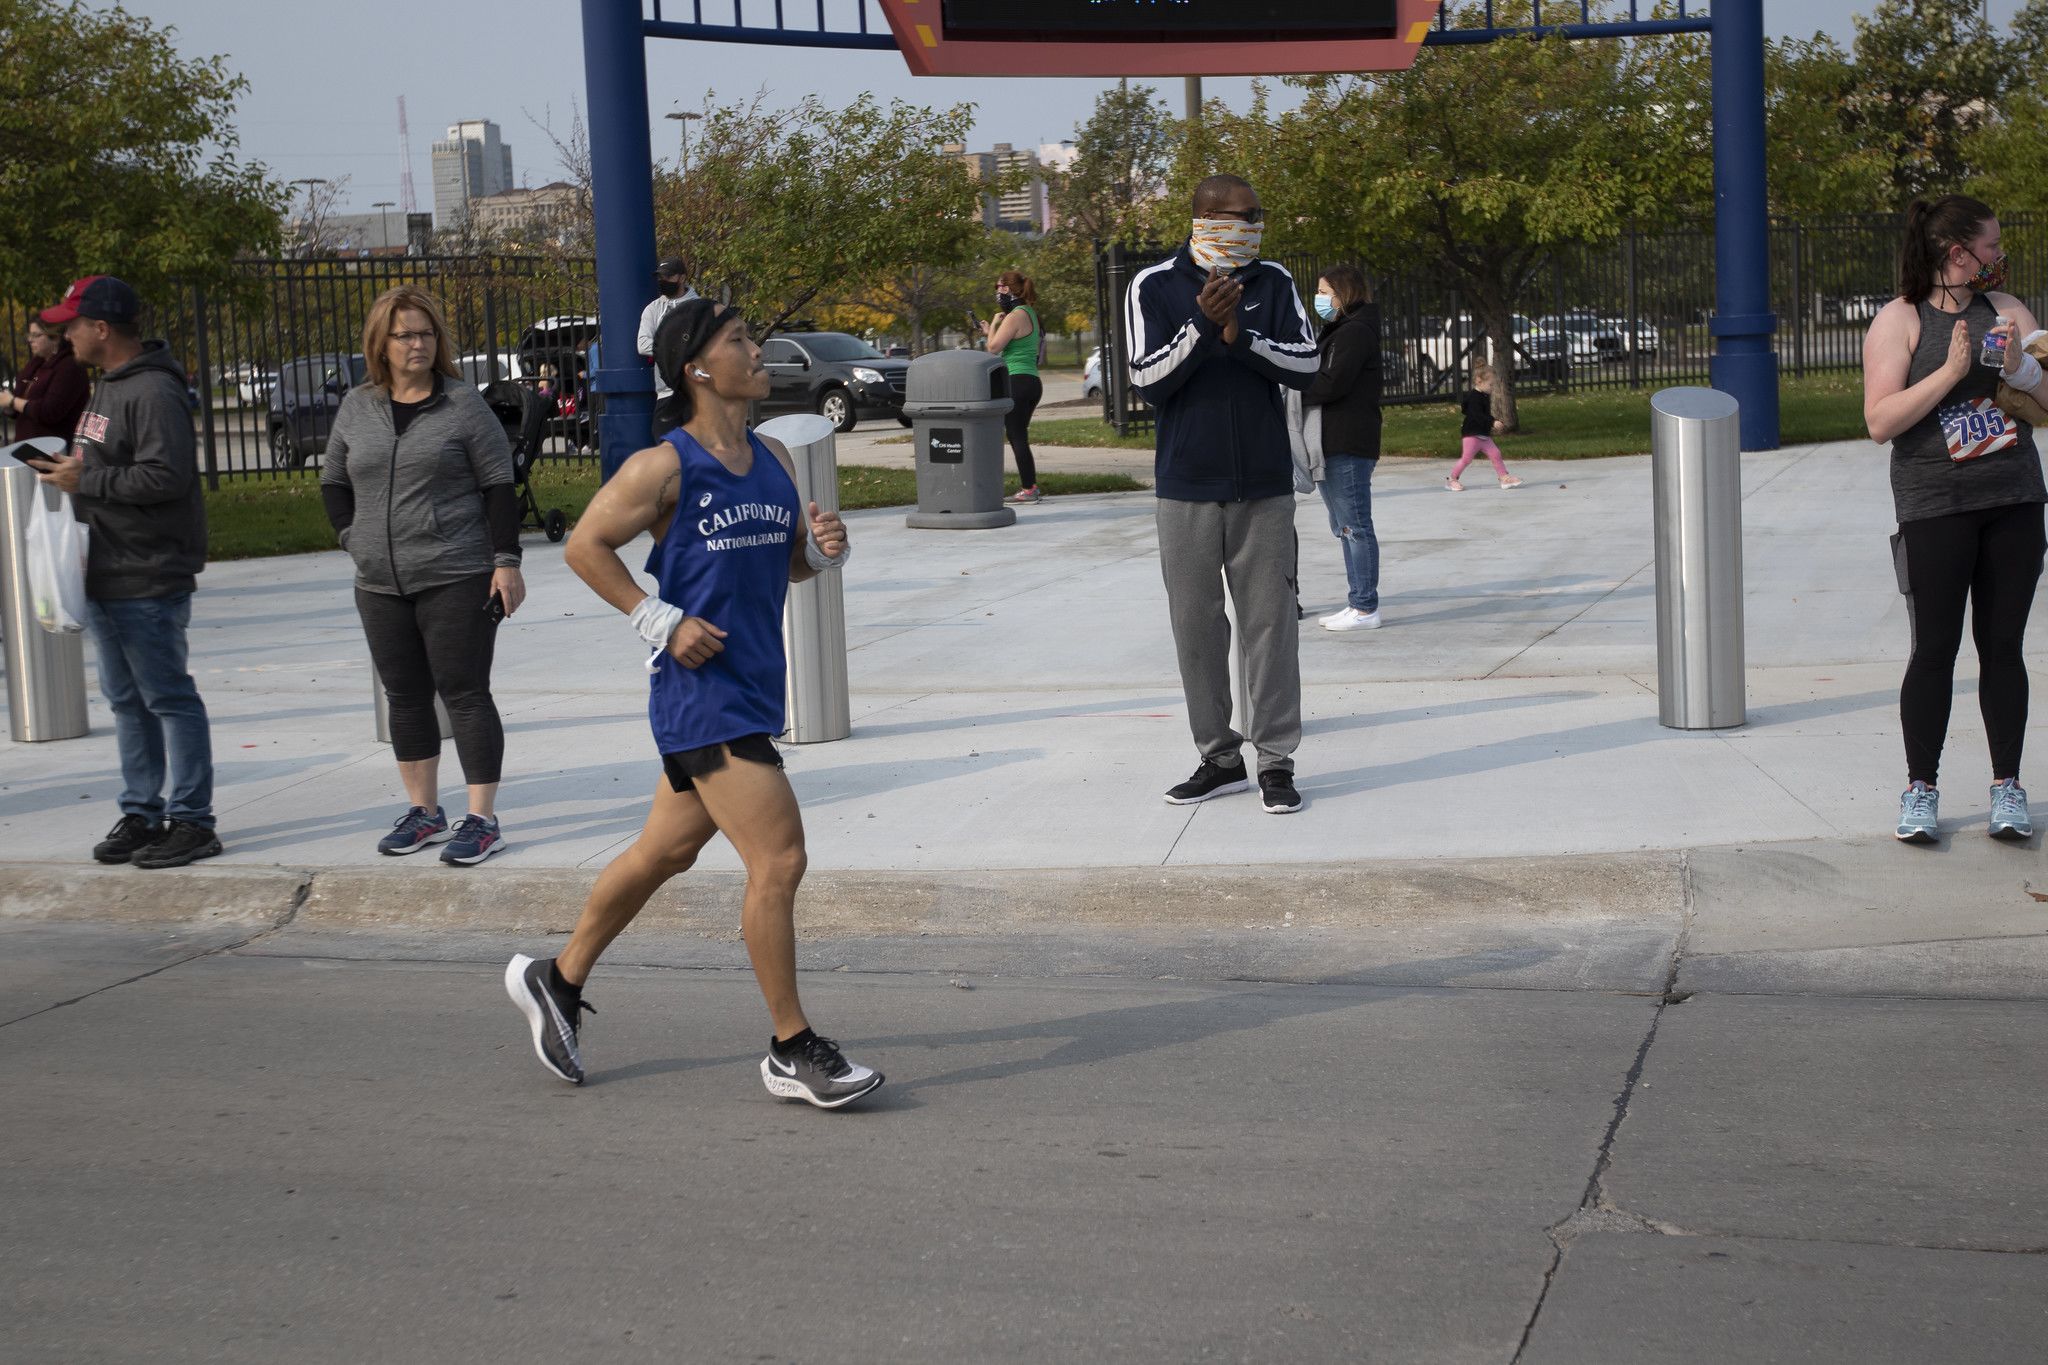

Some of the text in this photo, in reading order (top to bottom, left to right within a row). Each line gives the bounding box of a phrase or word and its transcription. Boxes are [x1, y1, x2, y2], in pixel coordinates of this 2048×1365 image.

[1952, 407, 2006, 447] 795
[698, 503, 791, 536] CALIFORNIA
[706, 531, 787, 552] NATIONAL GUARD
